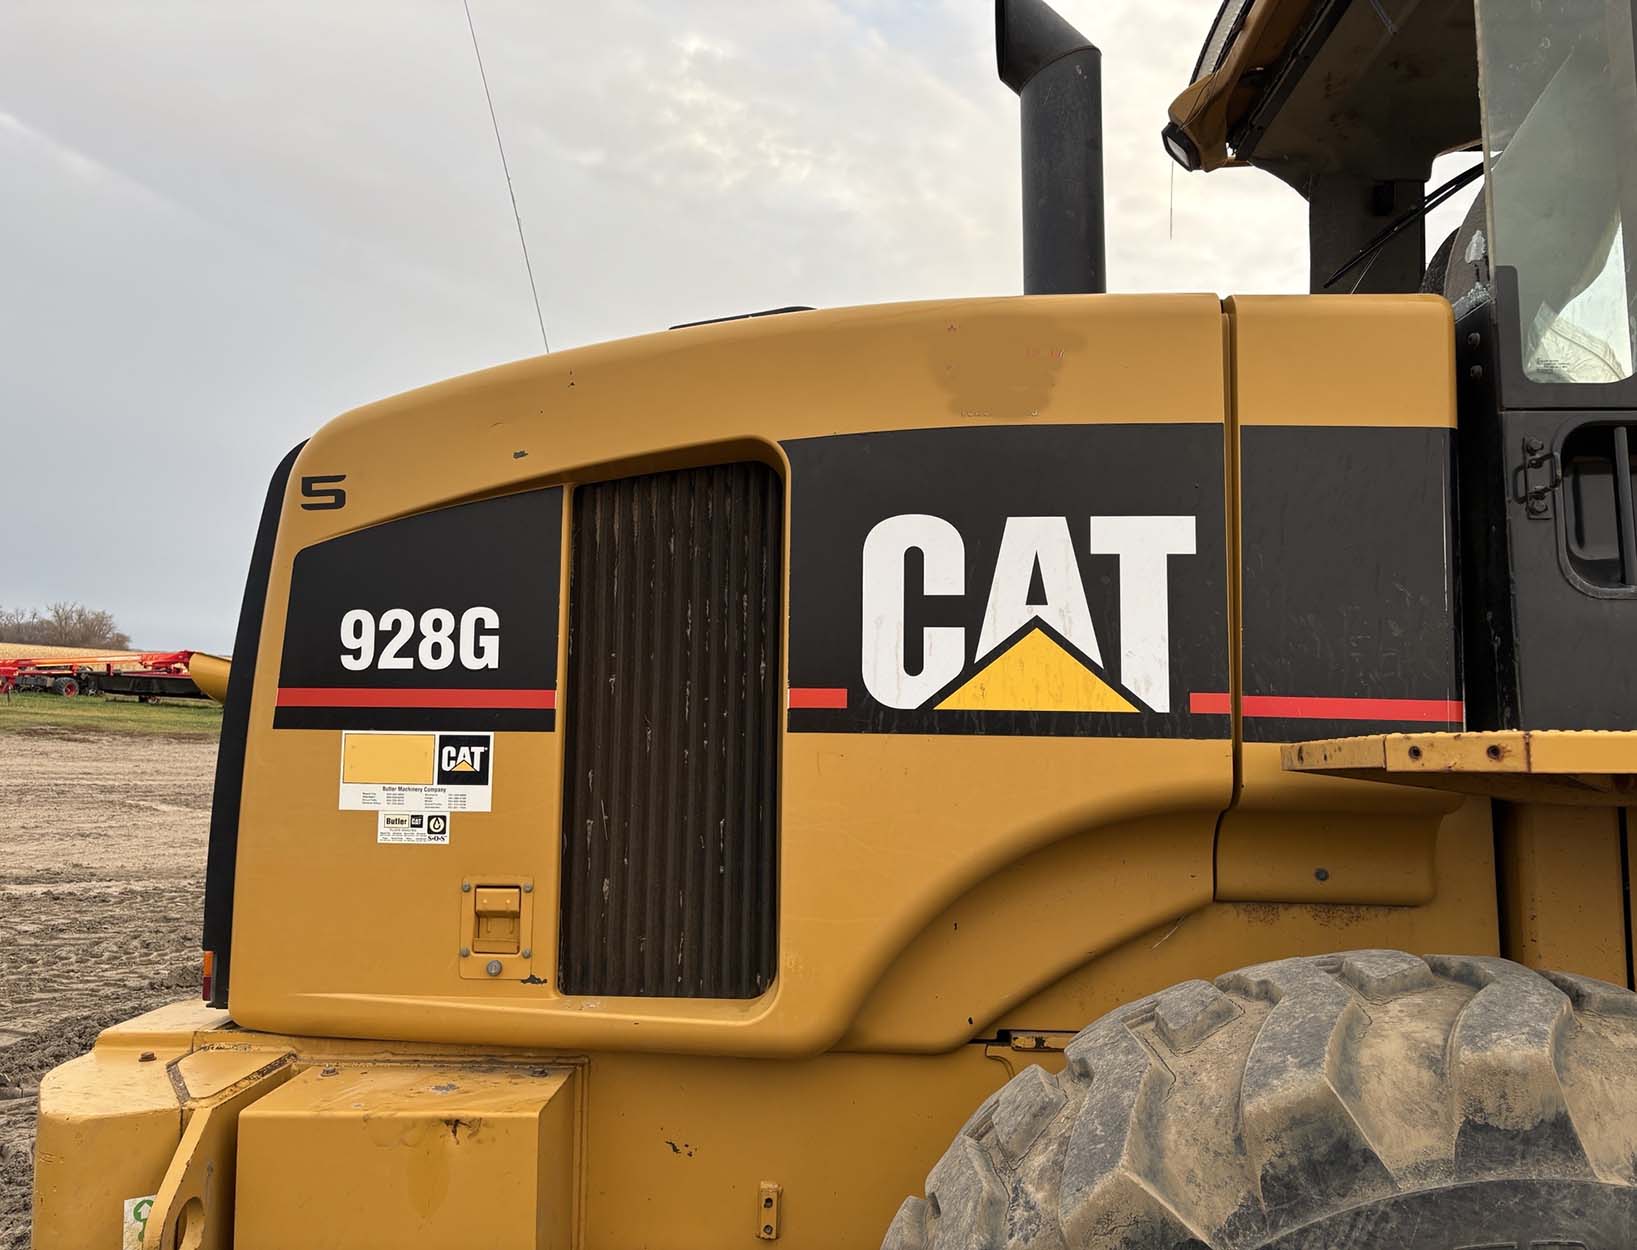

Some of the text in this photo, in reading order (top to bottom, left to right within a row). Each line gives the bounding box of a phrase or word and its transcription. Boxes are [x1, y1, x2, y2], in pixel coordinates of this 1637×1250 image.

[862, 513, 1197, 714] CAT
[340, 606, 500, 671] 928G
[441, 746, 486, 773] CAT
[386, 817, 407, 826] Butler
